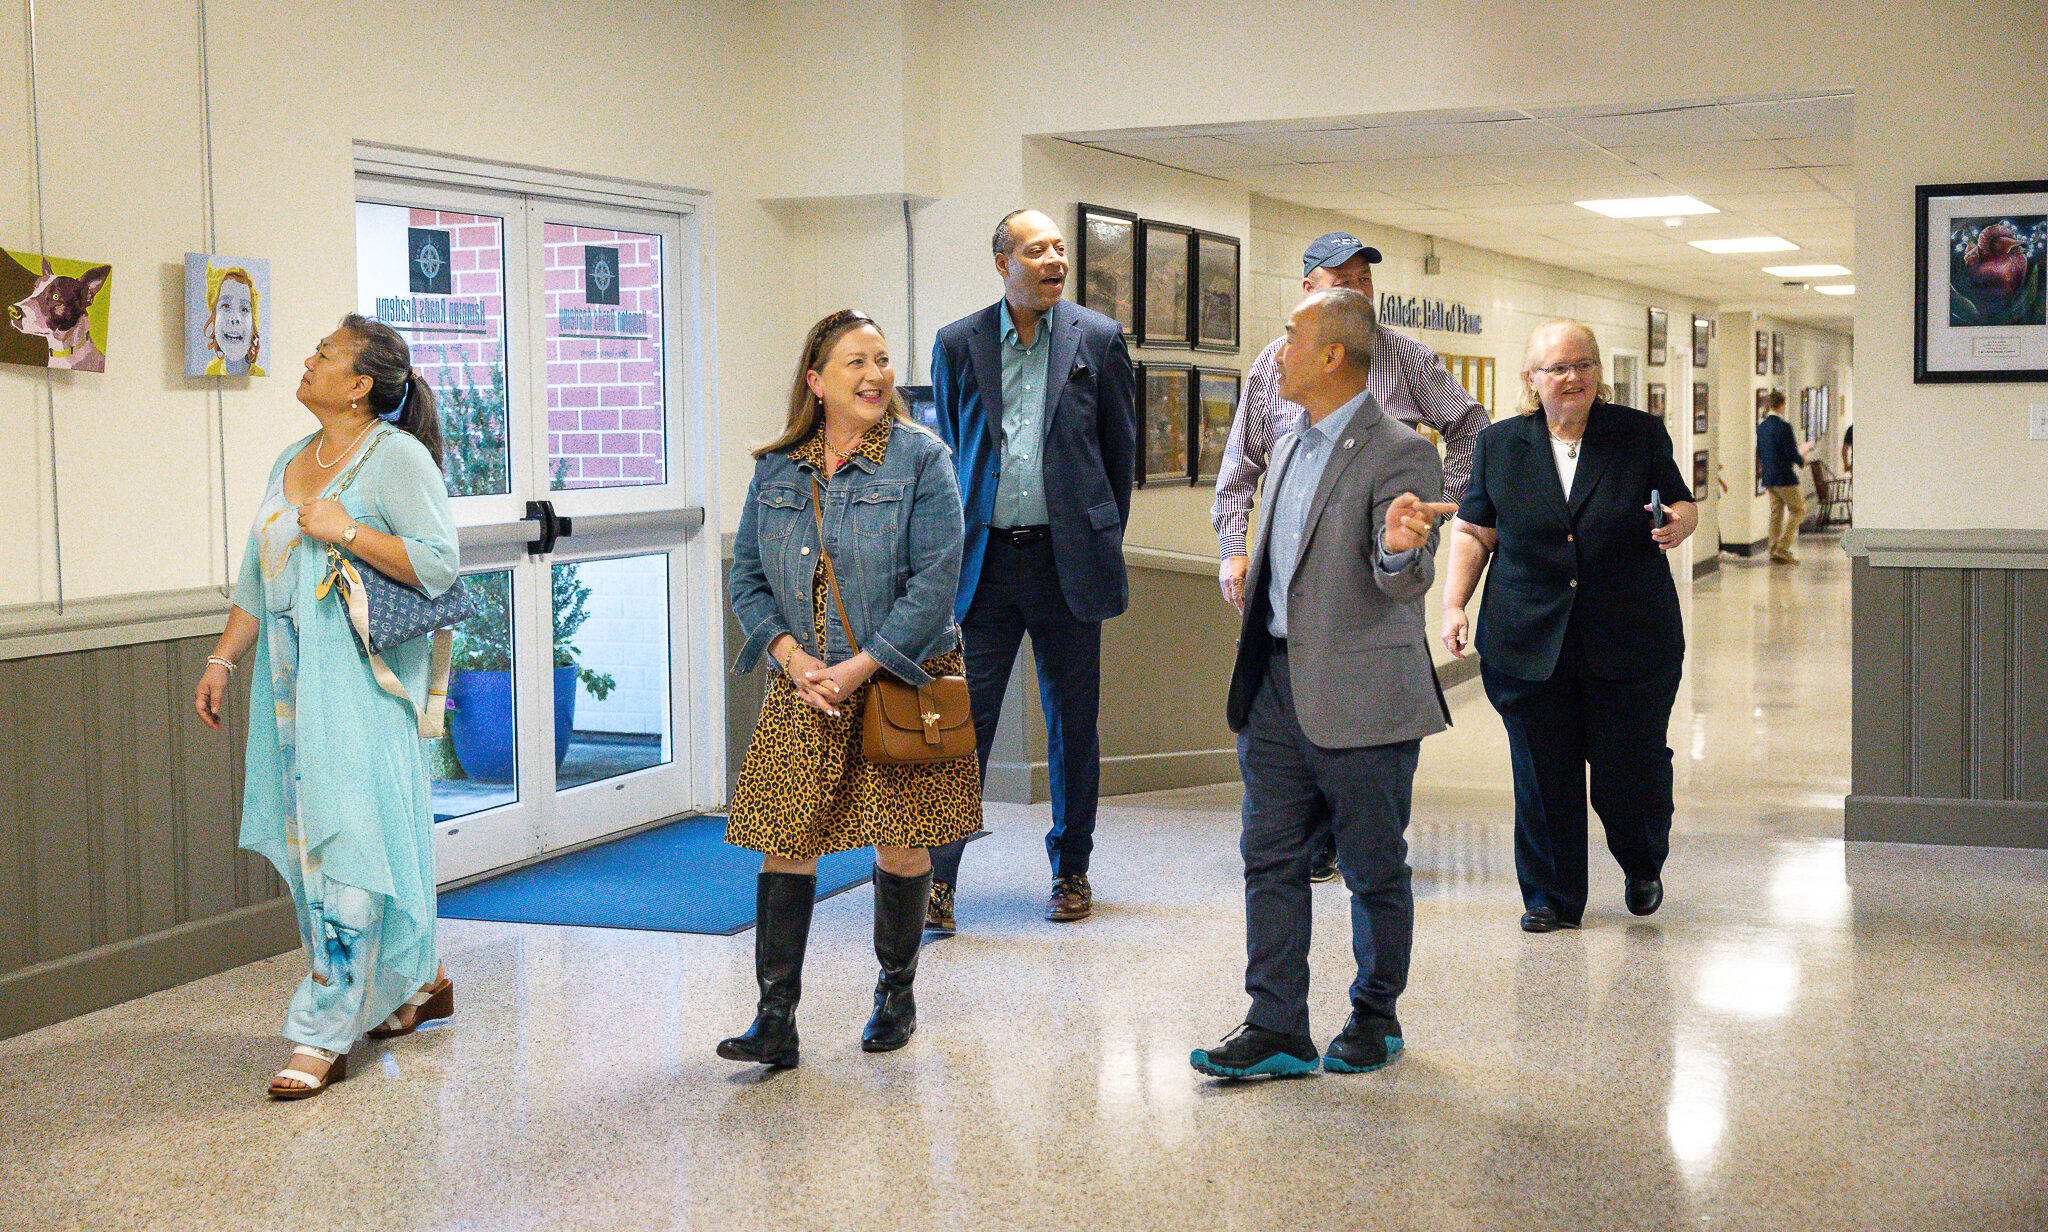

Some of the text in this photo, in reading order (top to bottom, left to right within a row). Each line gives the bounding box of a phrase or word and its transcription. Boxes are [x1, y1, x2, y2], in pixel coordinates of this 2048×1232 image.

[1378, 292, 1483, 335] Athletic Hall of Fame
